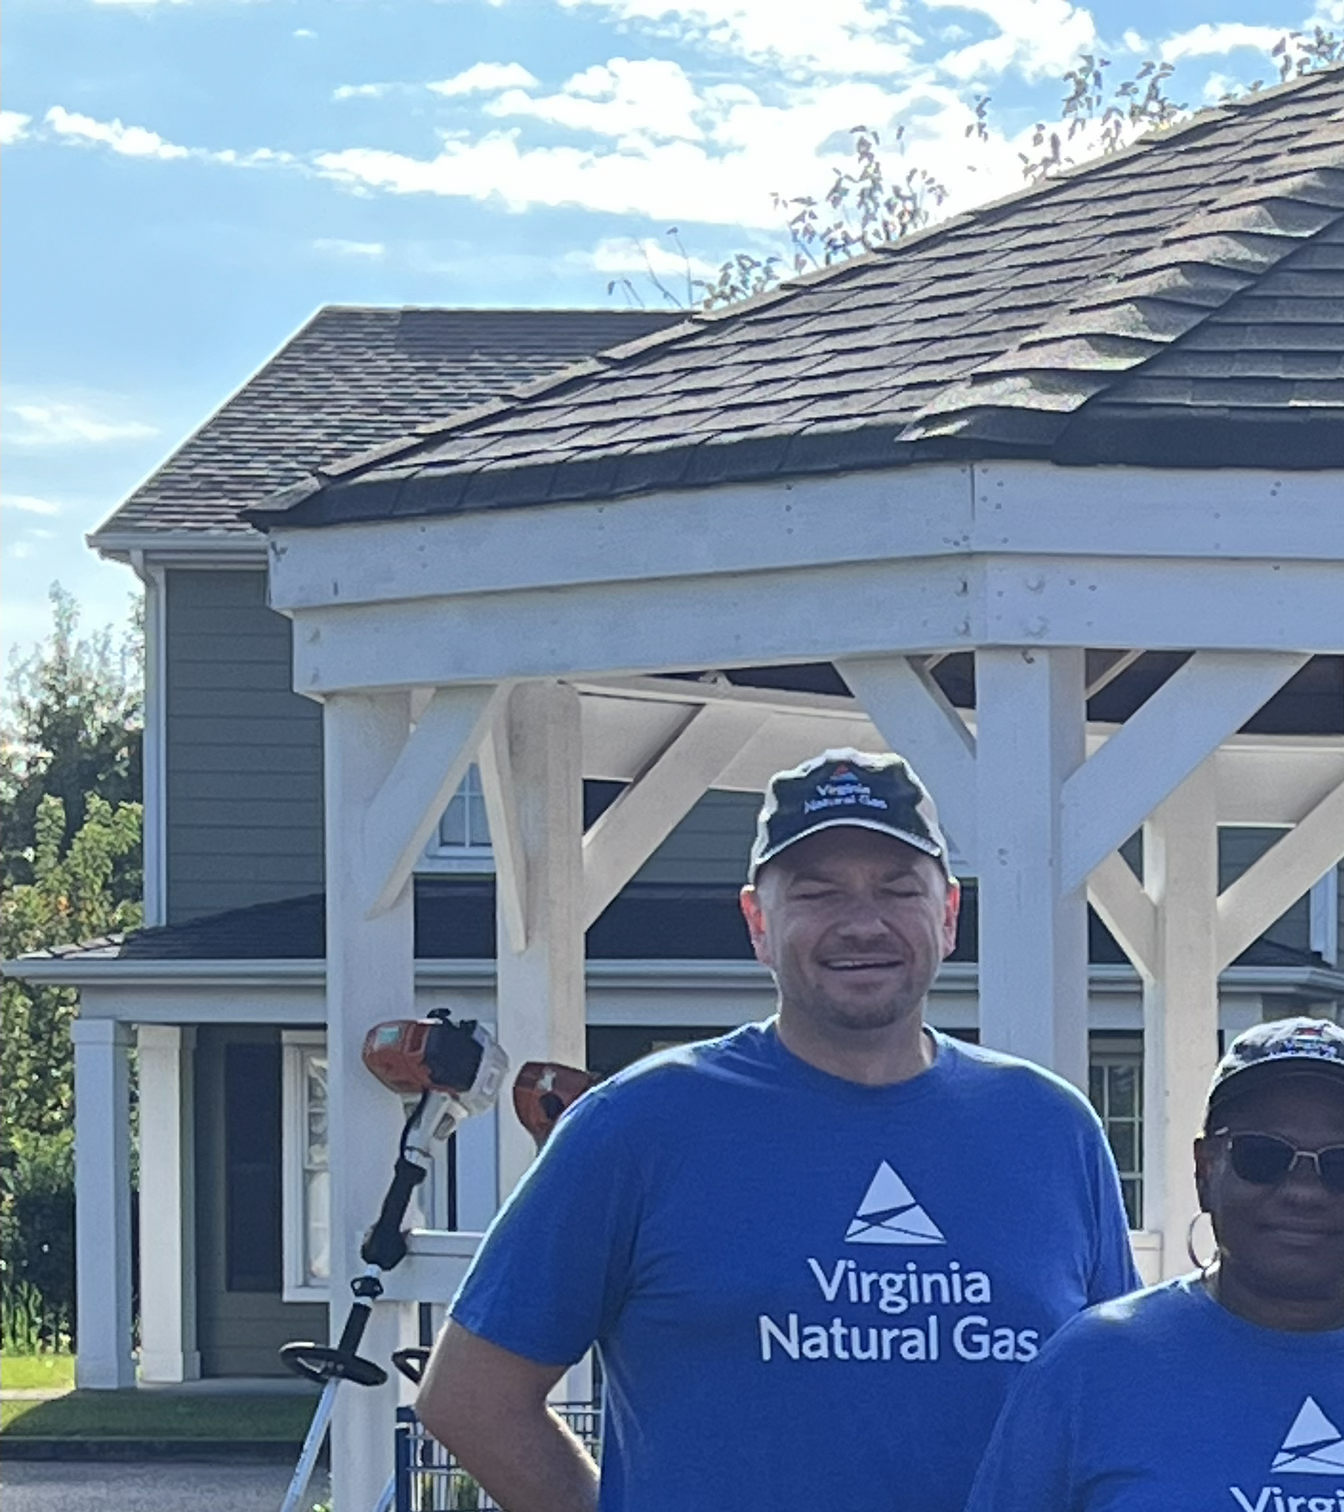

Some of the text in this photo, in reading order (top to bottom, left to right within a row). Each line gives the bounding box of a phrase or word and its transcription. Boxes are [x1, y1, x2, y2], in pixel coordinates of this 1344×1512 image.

[807, 1257, 992, 1313] Virginia
[758, 1313, 1039, 1362] Natural Gas
